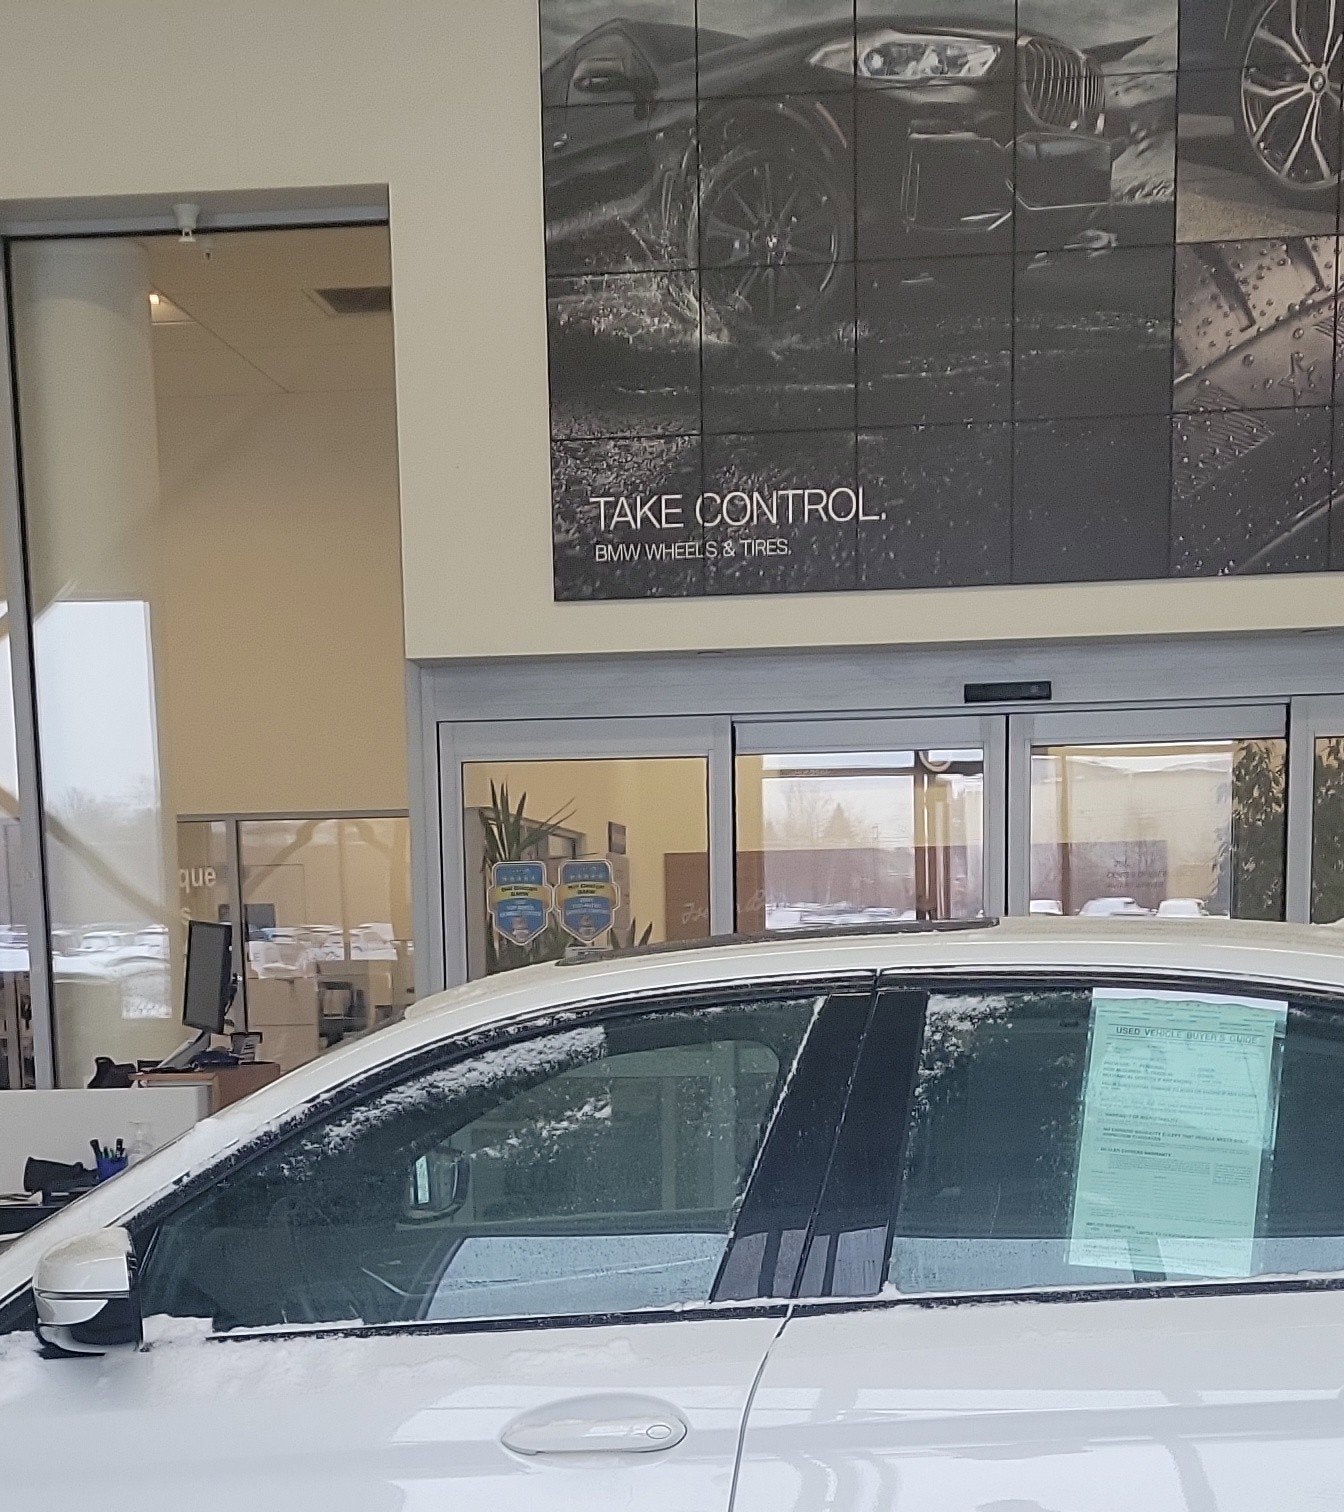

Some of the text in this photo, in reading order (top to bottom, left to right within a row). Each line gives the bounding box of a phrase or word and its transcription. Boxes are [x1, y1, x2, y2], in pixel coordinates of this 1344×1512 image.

[589, 485, 887, 531] TAKE CONTROL.
[595, 538, 792, 562] BMW WHEELS & TIRES.
[1116, 1026, 1141, 1036] USED
[1144, 1028, 1183, 1039] VEHICLE
